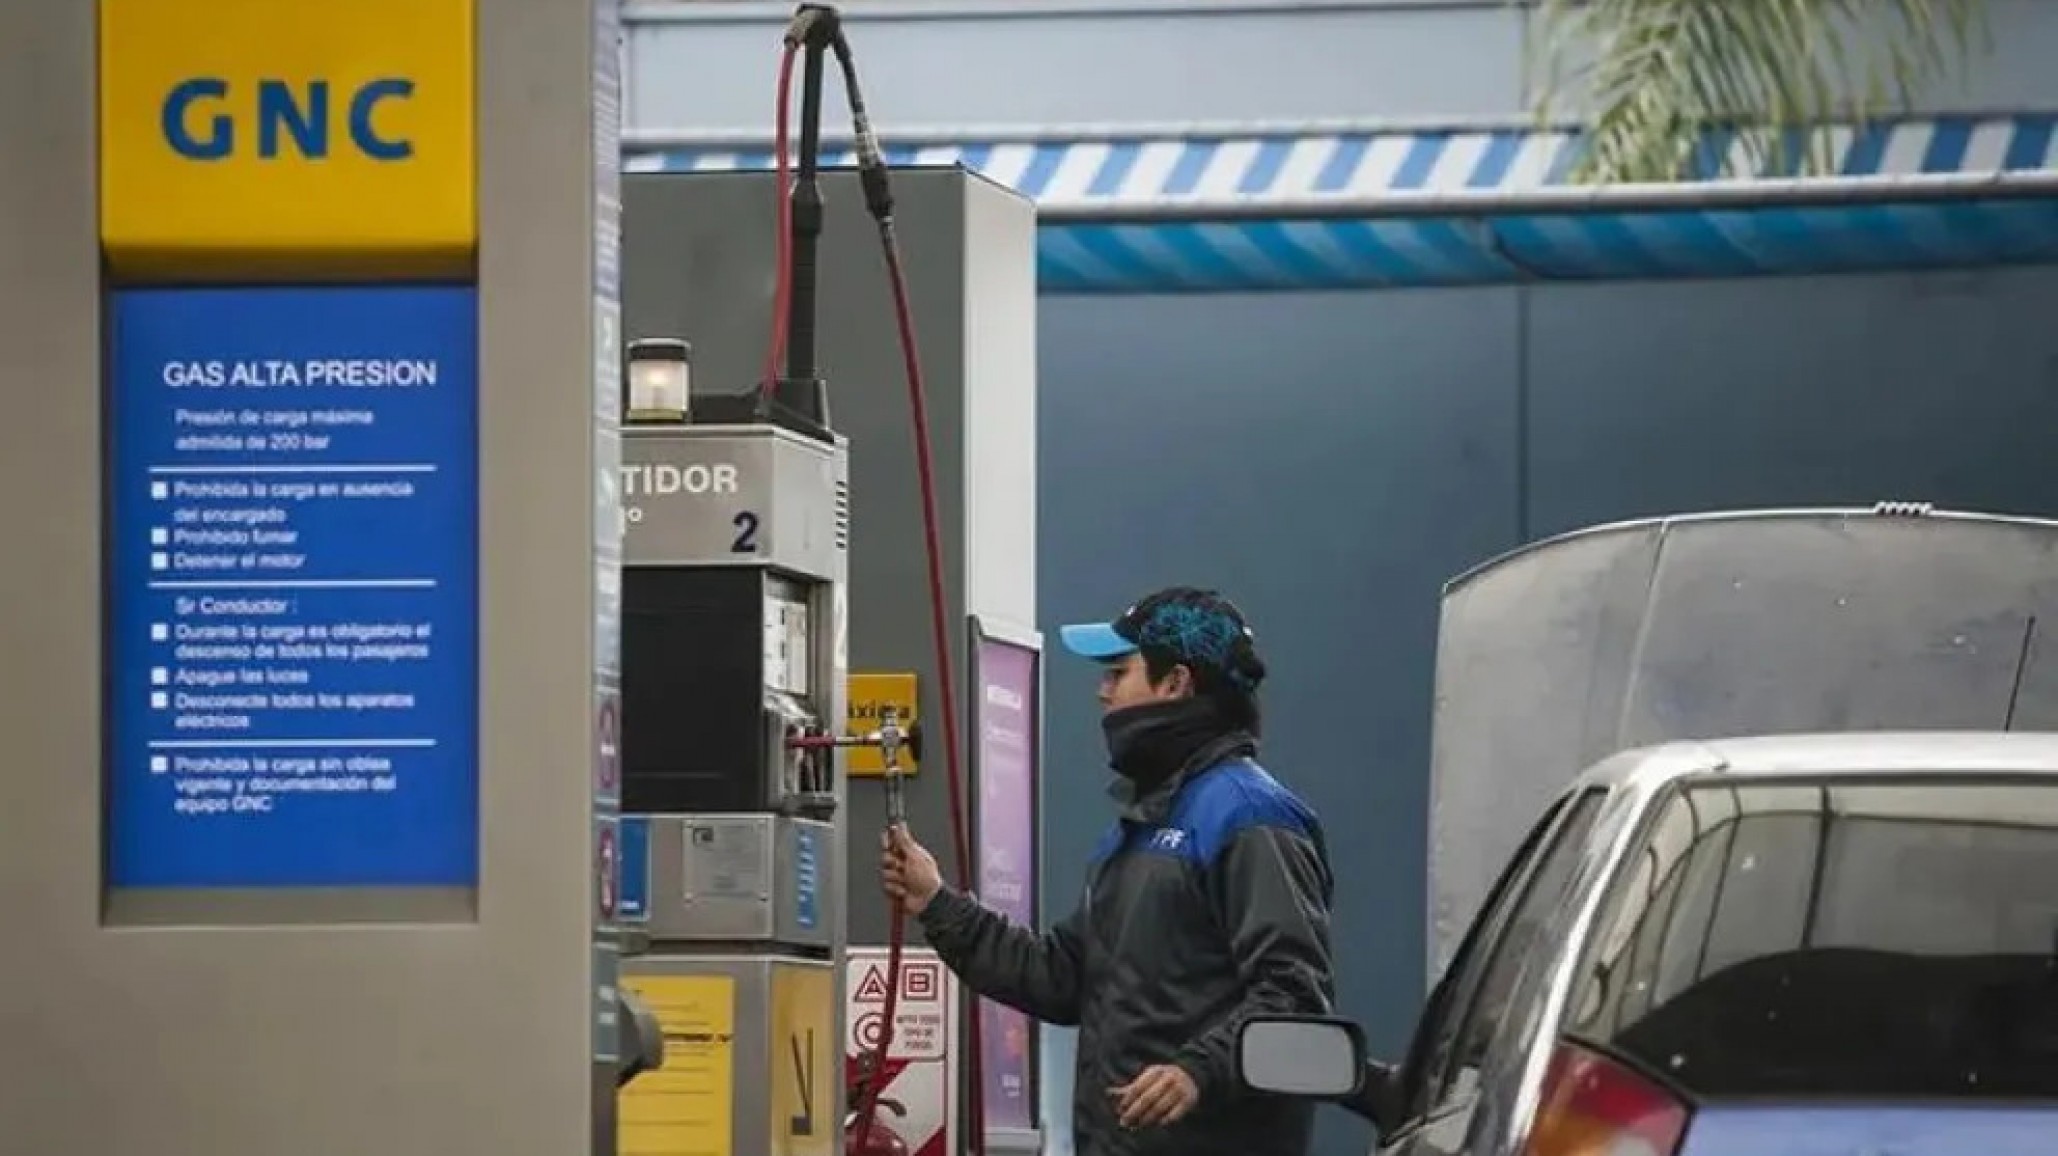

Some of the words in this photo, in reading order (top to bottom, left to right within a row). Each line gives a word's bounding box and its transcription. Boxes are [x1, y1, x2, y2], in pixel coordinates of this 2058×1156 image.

[161, 78, 416, 161] GNC
[164, 361, 226, 386] GAS
[229, 361, 300, 386] ALTA
[306, 359, 437, 386] PRESION
[239, 409, 260, 425] de
[263, 411, 308, 428] carga
[246, 436, 266, 450] de
[270, 433, 301, 450] 200
[304, 434, 329, 449] bar
[619, 465, 738, 494] TIDOR
[174, 481, 249, 497] Prohibida
[252, 482, 267, 496] la
[270, 484, 316, 500] carga
[318, 484, 338, 496] en
[343, 482, 414, 496] ausencia
[174, 509, 199, 523] del
[203, 508, 287, 525] encargado
[174, 529, 249, 544] Prohibido
[253, 529, 298, 544] fumar
[730, 511, 757, 552] 2
[174, 552, 236, 569] Detener
[240, 554, 256, 568] el
[259, 554, 305, 568] motor
[199, 597, 287, 614] Conductor
[175, 624, 239, 640] Durante
[242, 625, 258, 639] la
[260, 626, 306, 641] carga
[307, 625, 327, 639] es
[331, 623, 412, 641] obligatorio
[415, 624, 431, 638] el
[175, 645, 251, 660] descenso
[255, 644, 275, 658] de
[278, 643, 323, 658] todos
[326, 643, 350, 658] los
[351, 643, 429, 660] pasajeros
[175, 668, 236, 687] Apague
[240, 669, 264, 683] las
[267, 670, 308, 683] luces
[174, 693, 268, 710] Desconecte
[272, 693, 316, 708] todos
[319, 693, 343, 708] los
[346, 694, 414, 710] aparatos
[252, 758, 268, 772] la
[272, 759, 316, 775] carga
[319, 758, 343, 772] sin
[175, 778, 233, 795] vigente
[236, 780, 246, 796] y
[371, 776, 397, 791] del
[174, 797, 229, 813] equipo
[232, 796, 272, 811] GNC
